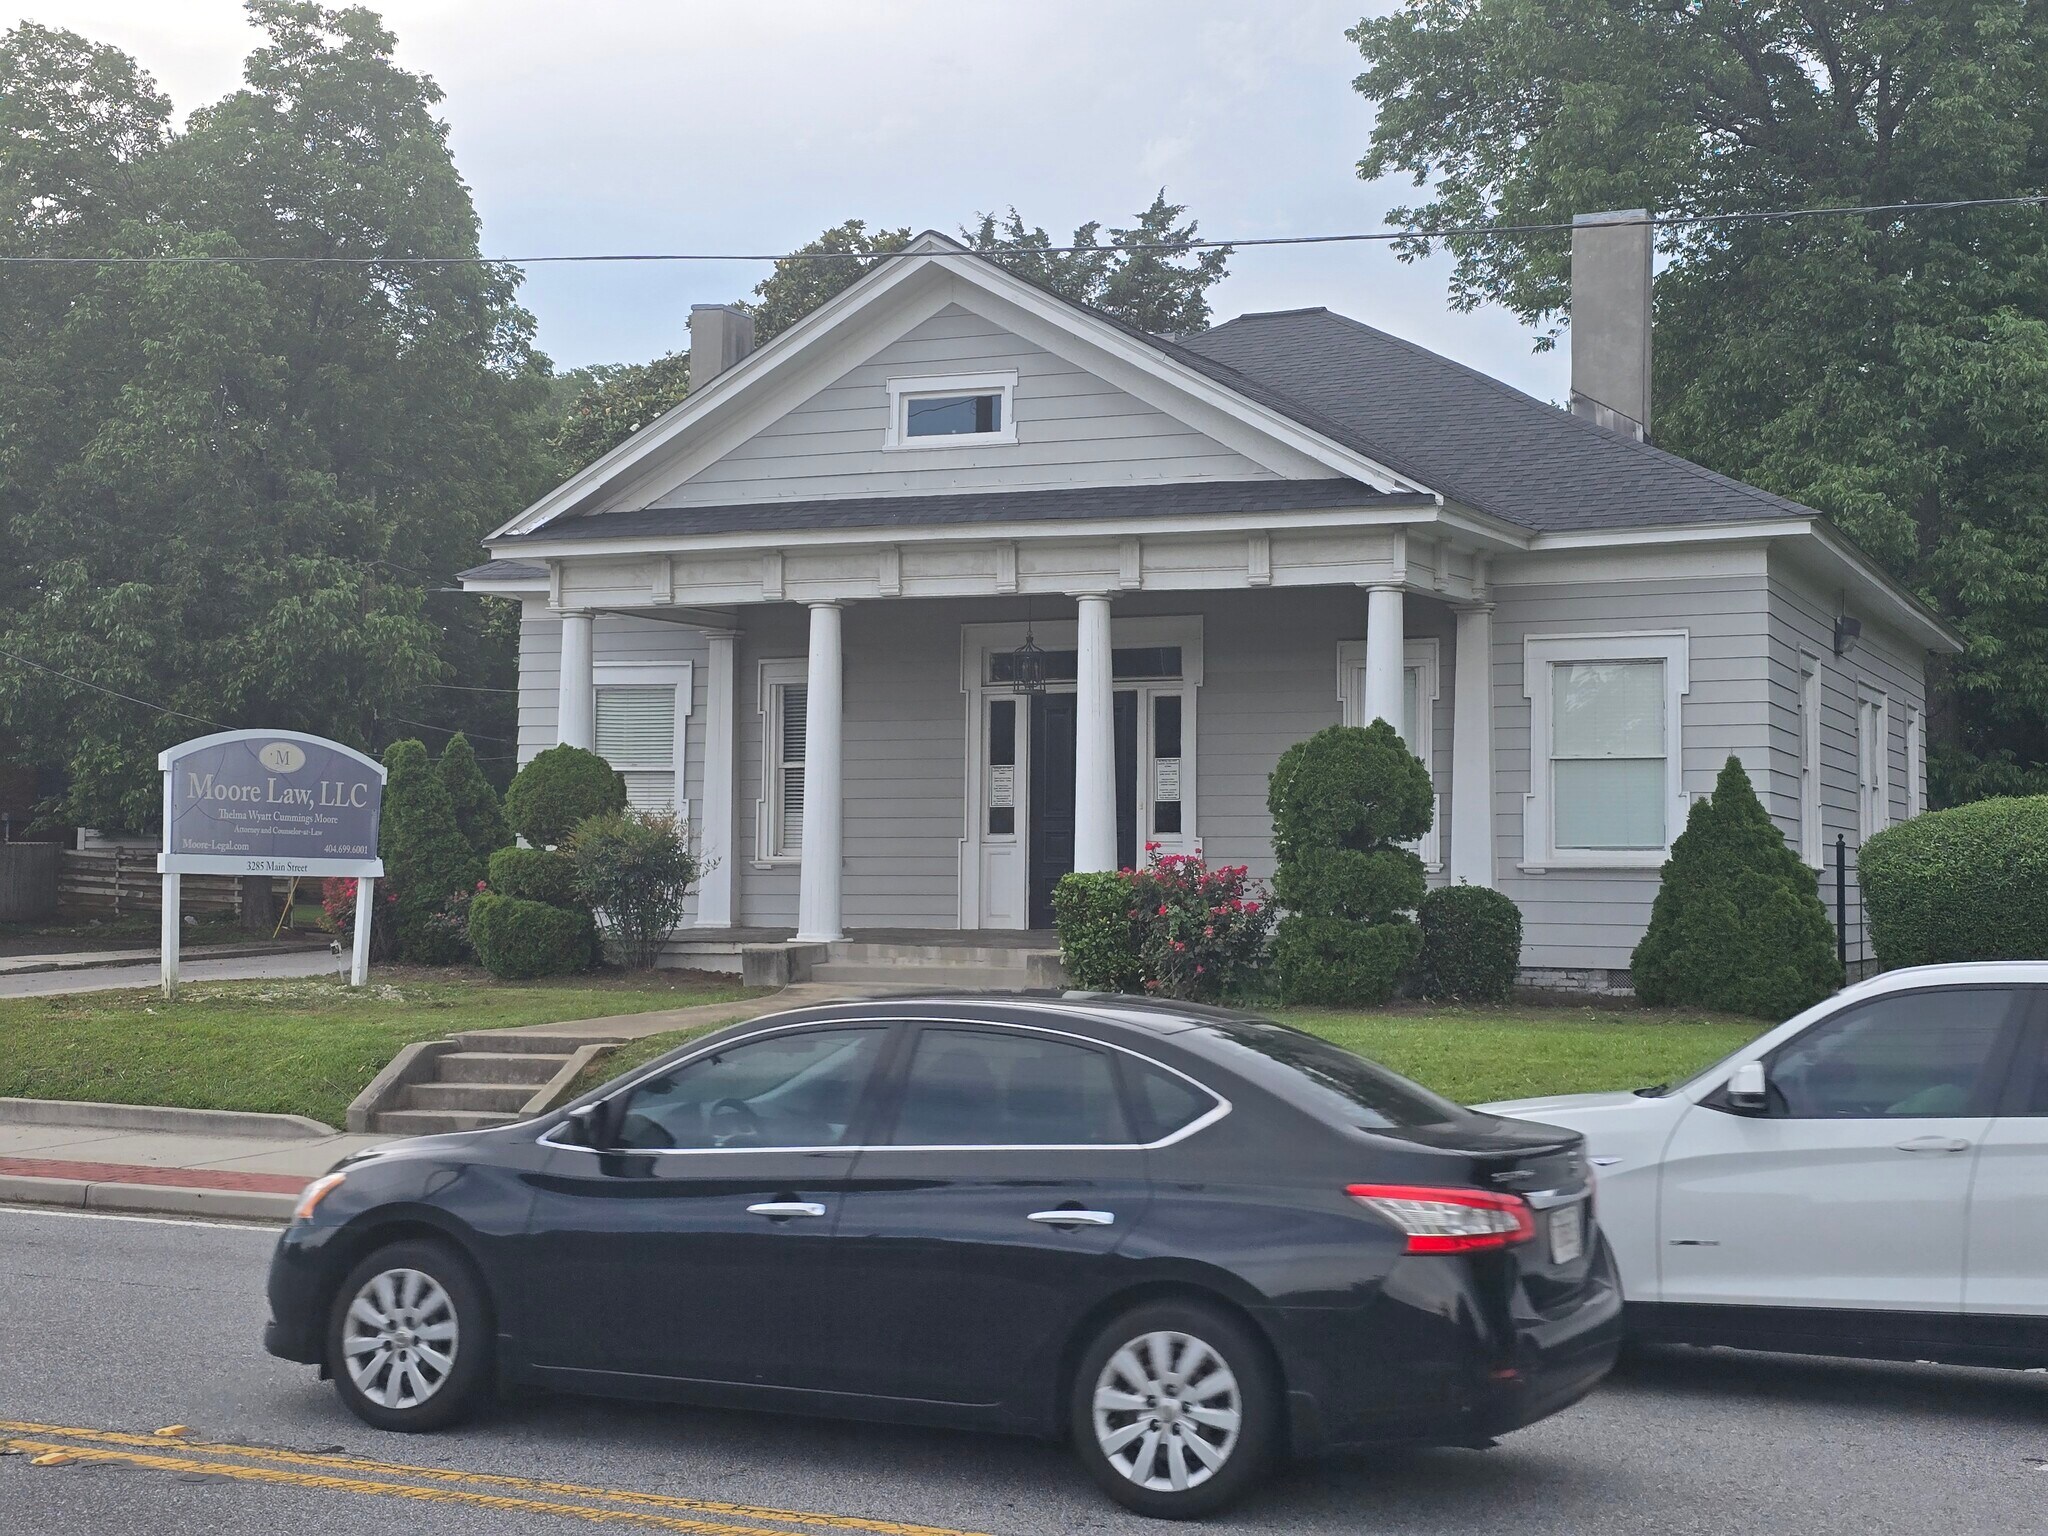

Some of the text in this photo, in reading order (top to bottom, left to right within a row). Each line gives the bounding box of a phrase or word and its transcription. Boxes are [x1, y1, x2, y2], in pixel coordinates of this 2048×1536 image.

[275, 750, 290, 765] M
[187, 772, 368, 811] Moore Law, LLC
[219, 808, 339, 825] Thelma Wyatt Cummings Moore
[234, 824, 323, 836] Attorney and Counselor-at-Law
[182, 838, 249, 852] Moore-Legal.com
[324, 844, 368, 854] 404.699.6001
[246, 861, 308, 872] 3285 Main Street
